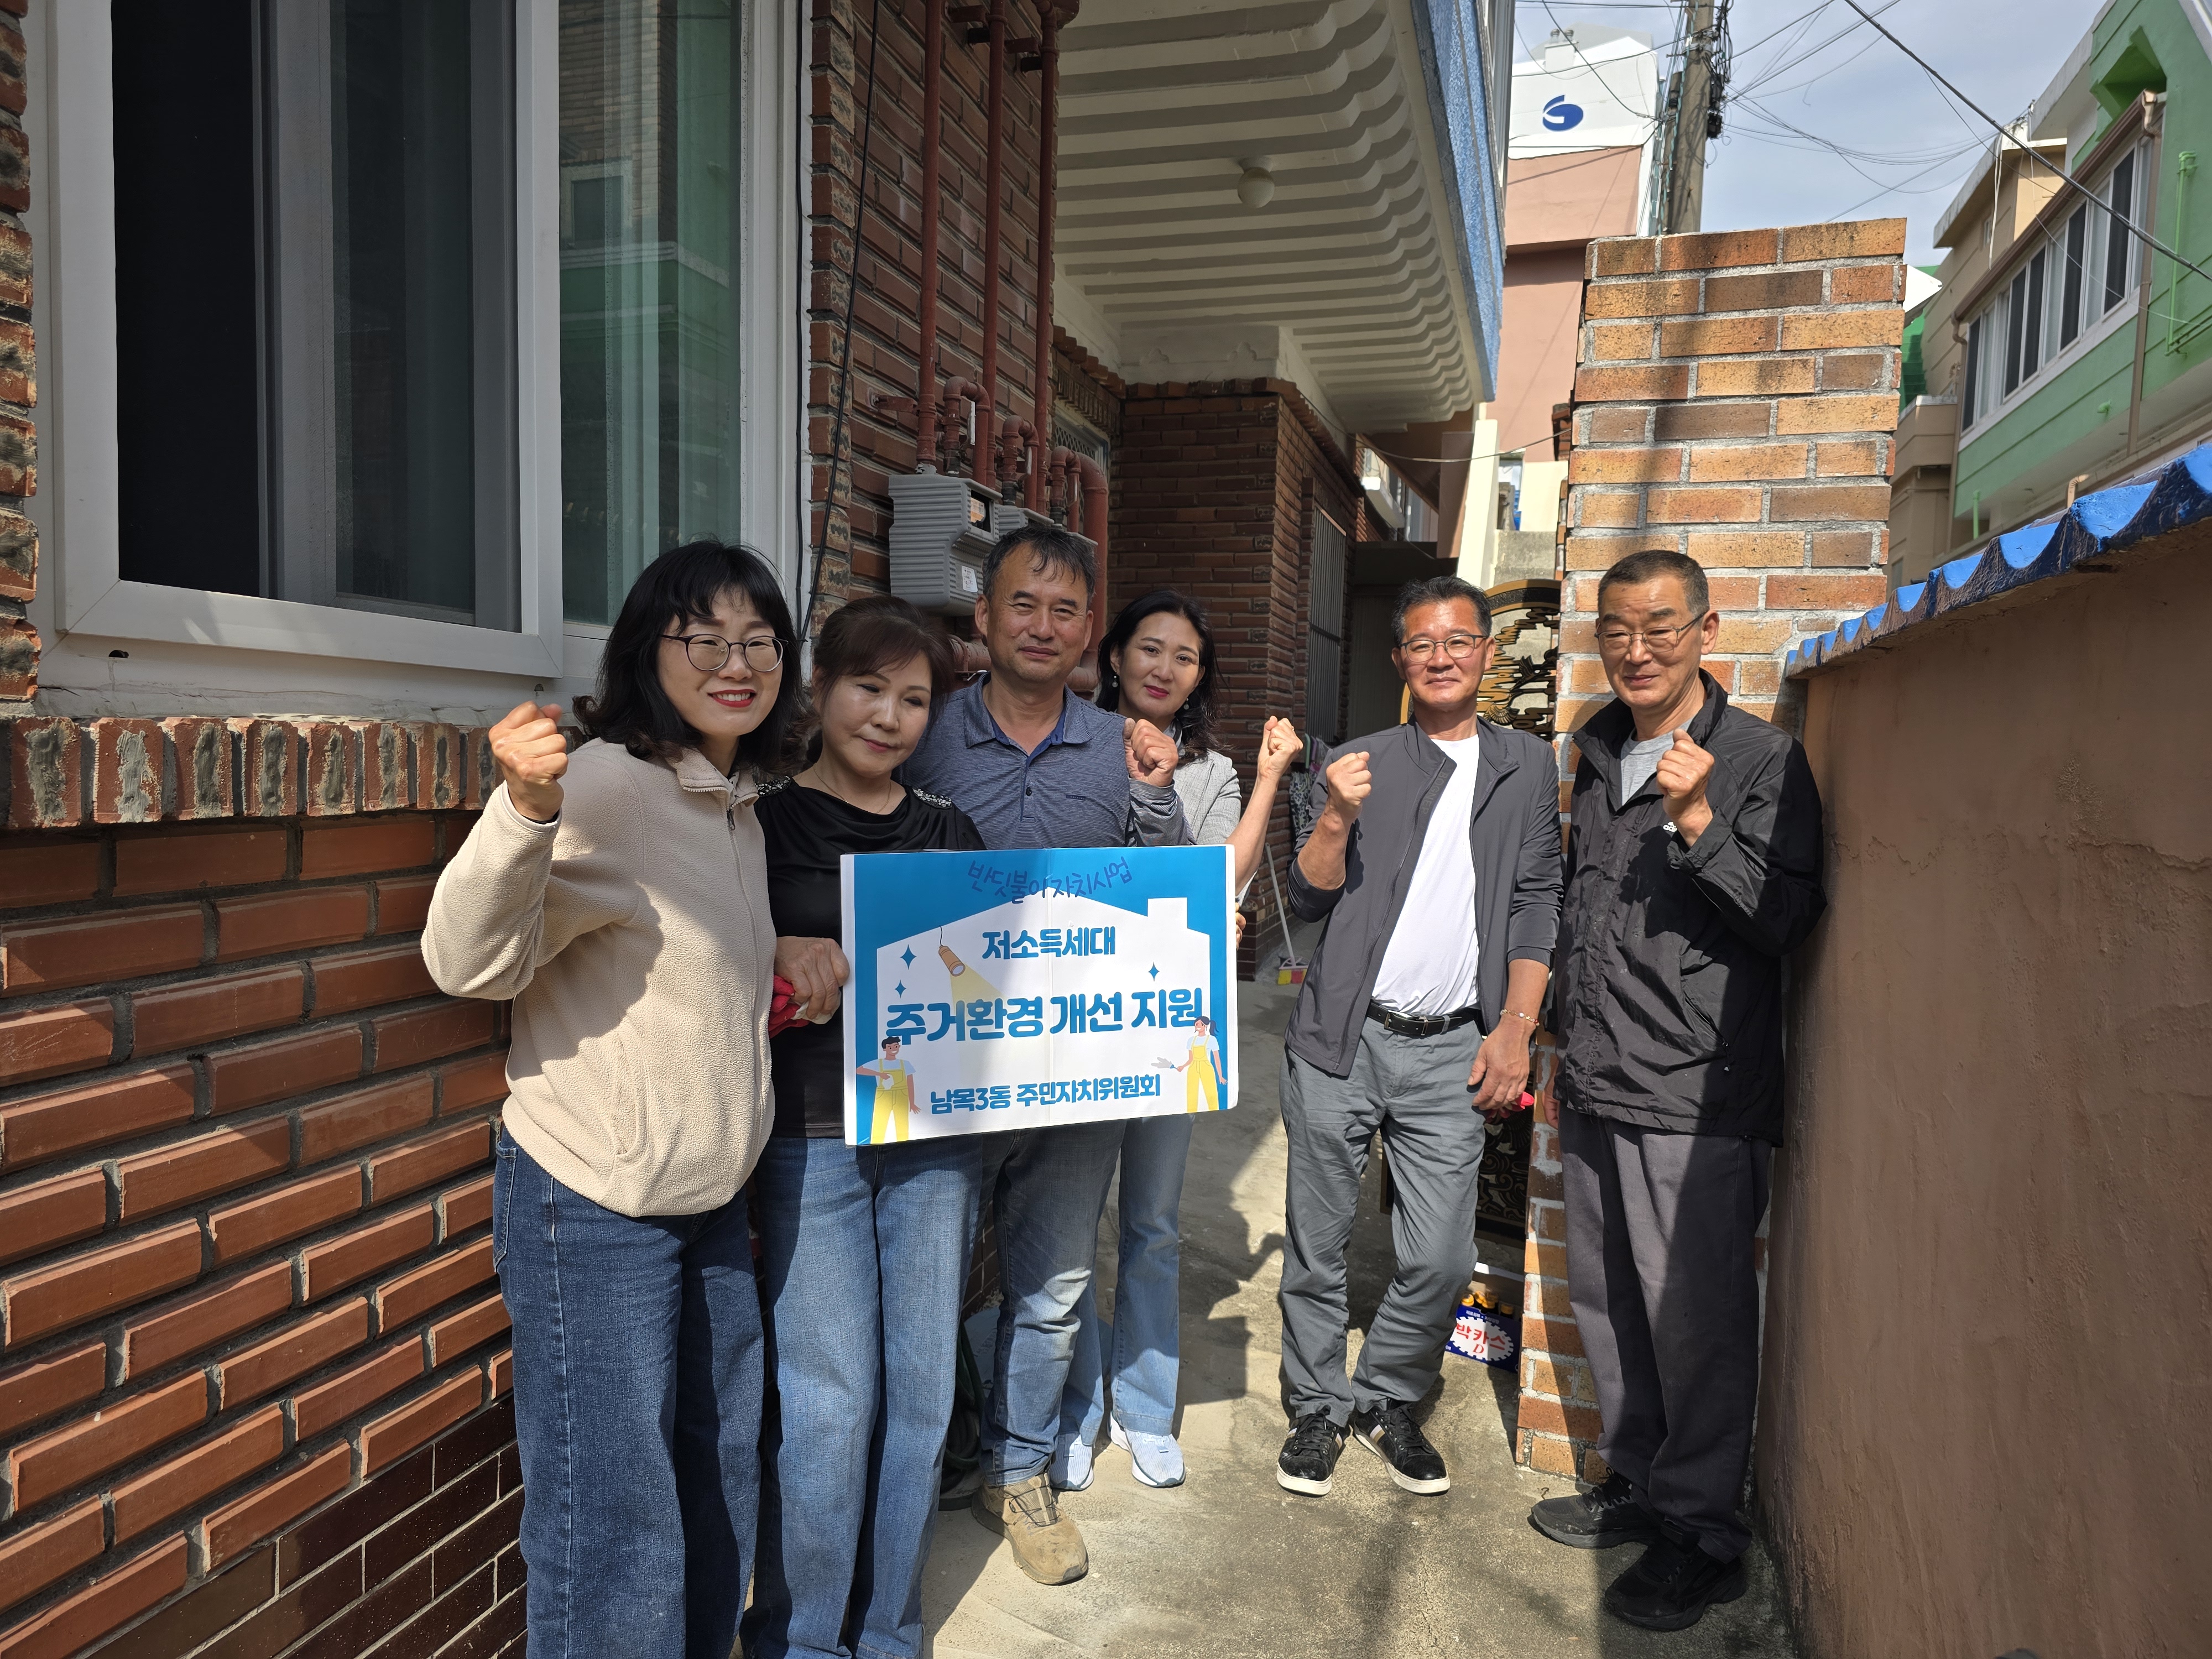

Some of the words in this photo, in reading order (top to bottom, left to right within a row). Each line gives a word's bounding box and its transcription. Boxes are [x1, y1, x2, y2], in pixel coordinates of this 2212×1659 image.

[1420, 771, 1448, 815] BOGNER
[968, 860, 1046, 904] 반딧불이
[1051, 856, 1133, 898] 자치사업
[982, 927, 1115, 959] 저소득세대
[886, 997, 1044, 1045] 주거환경
[1050, 993, 1123, 1034] 개선
[1131, 988, 1202, 1029] 지원
[931, 1086, 1011, 1114] 남목3동
[1016, 1074, 1160, 1107] 주민자치위원회
[1456, 1324, 1506, 1350] 박카스
[1473, 1344, 1484, 1354] D
